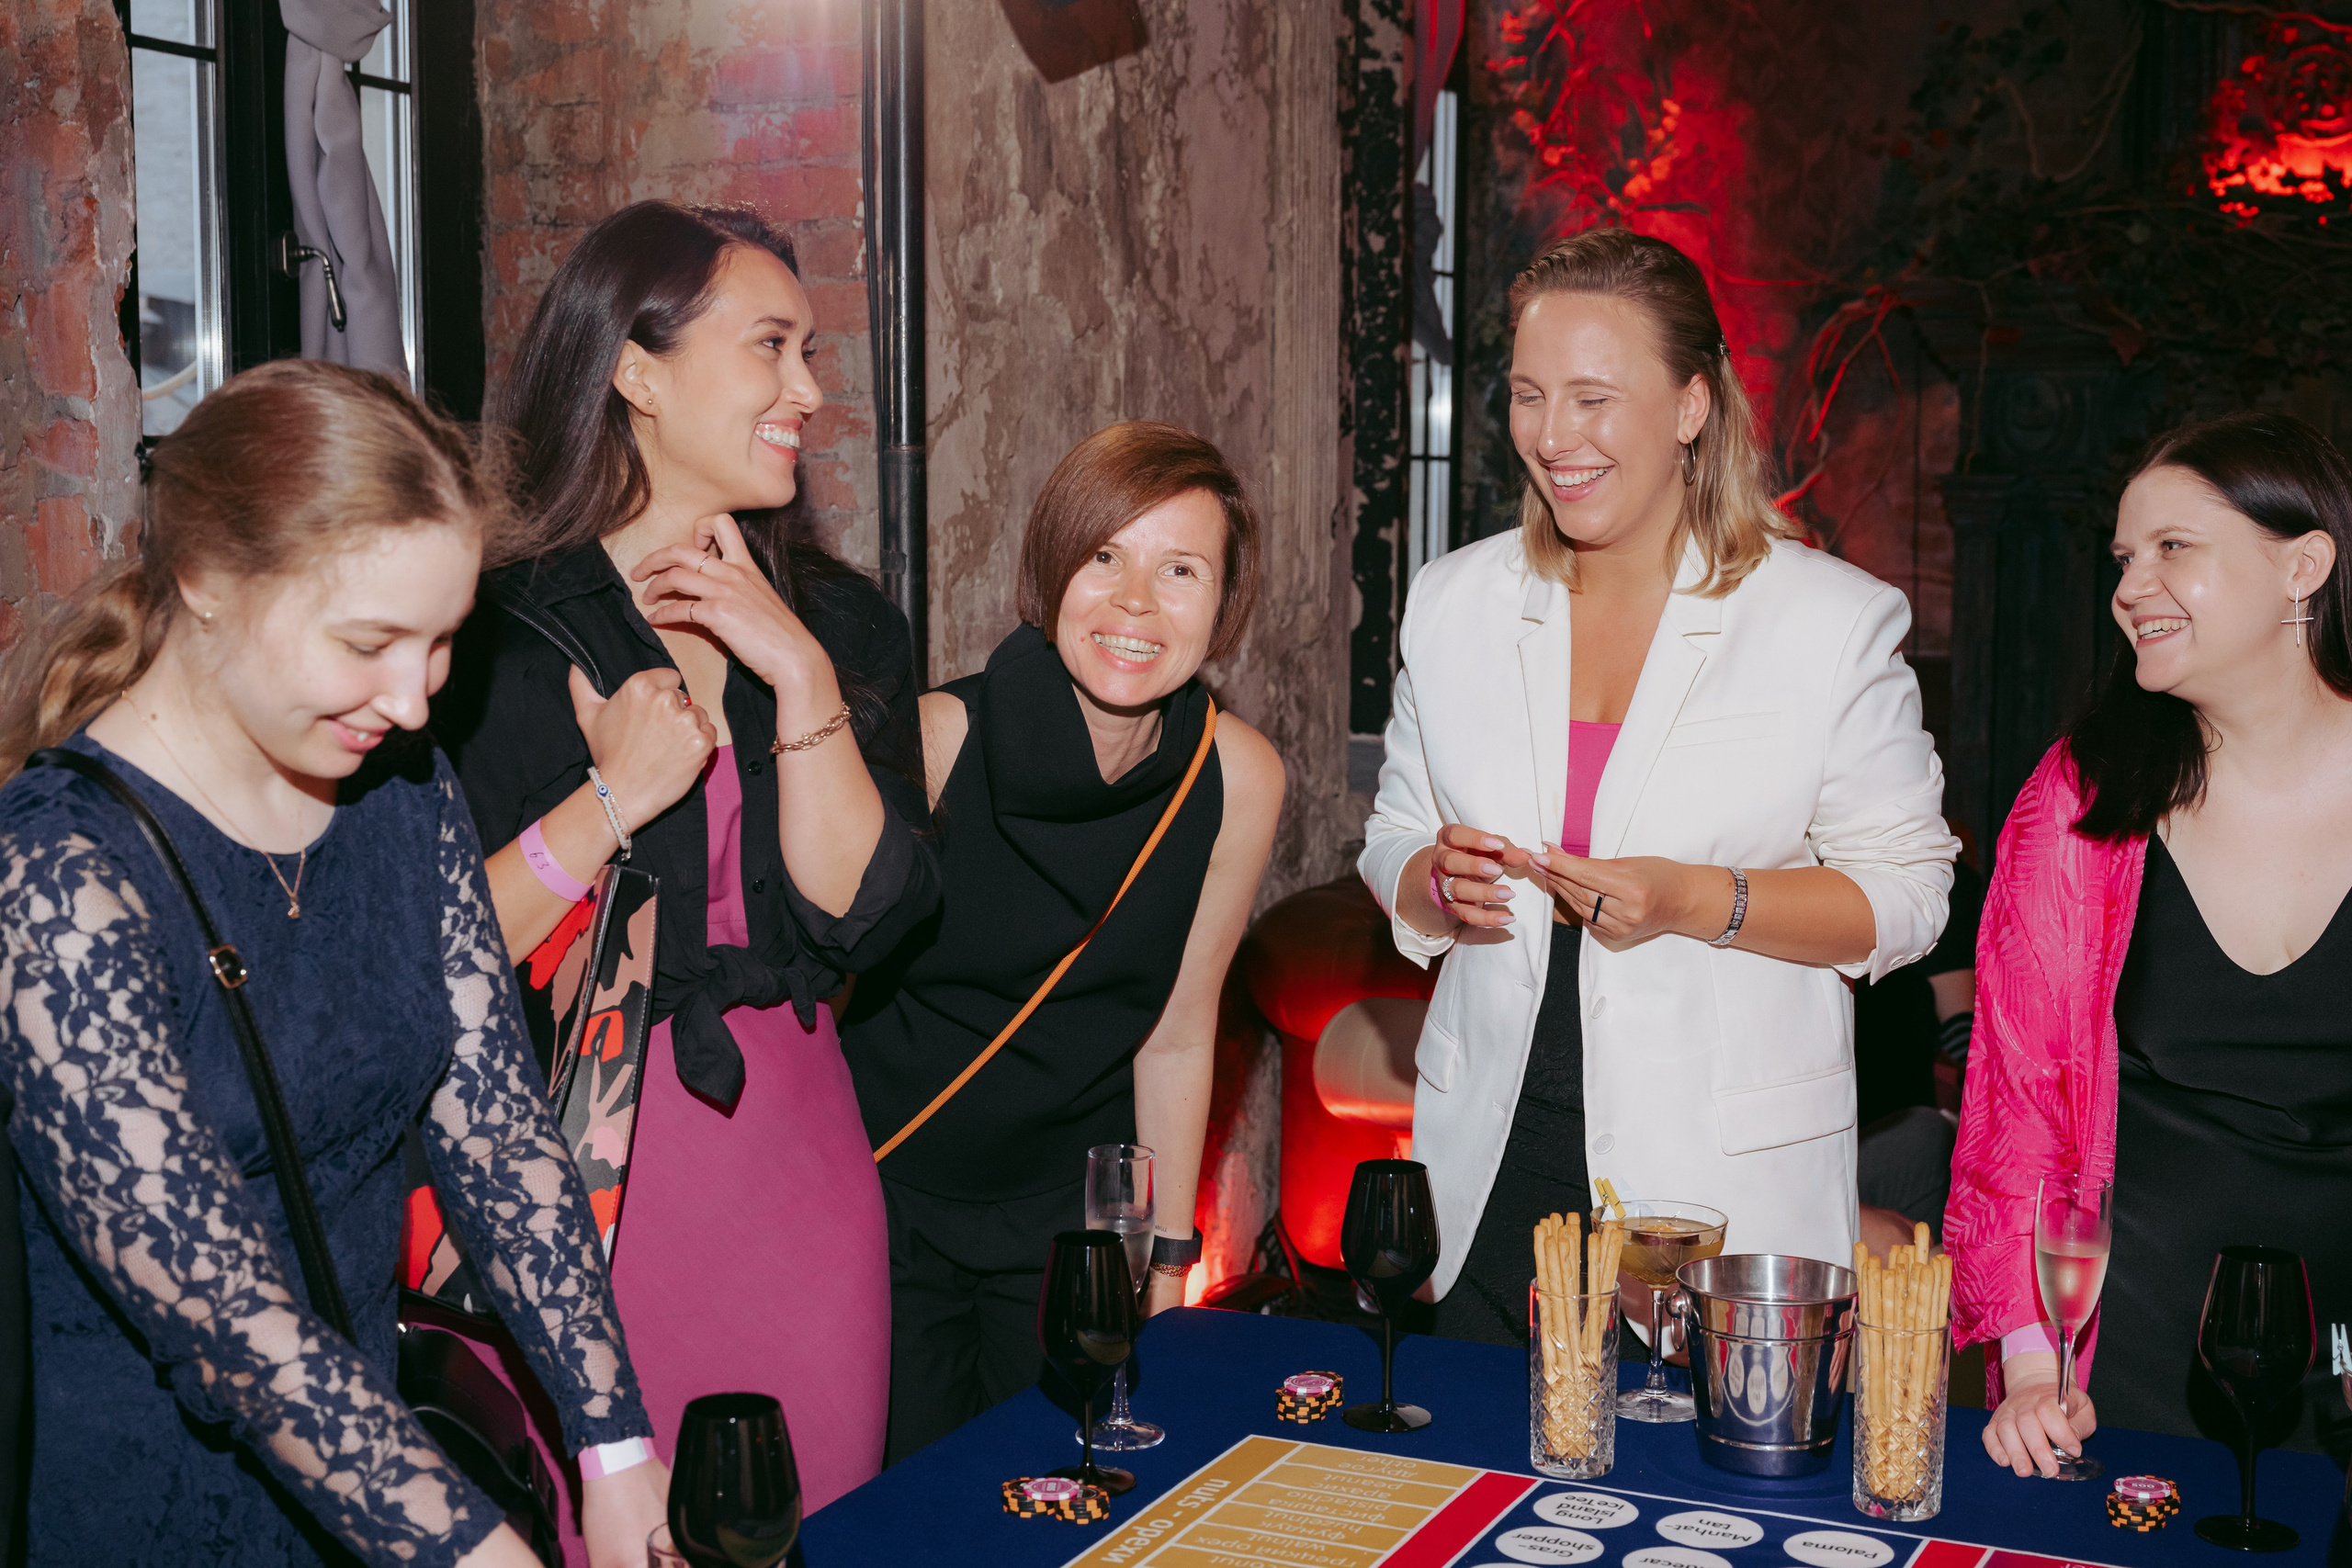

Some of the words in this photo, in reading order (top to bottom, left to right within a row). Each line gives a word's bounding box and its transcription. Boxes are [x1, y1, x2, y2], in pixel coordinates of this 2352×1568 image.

[1338, 1462, 1418, 1478] другое
[1357, 1456, 1417, 1468] other
[1323, 1473, 1404, 1490] peanut
[1177, 1478, 1231, 1508] nuts
[1311, 1483, 1391, 1498] арахис
[1287, 1491, 1391, 1511] pistachio
[1269, 1498, 1385, 1522] фисташка
[1555, 1510, 1603, 1525] Long
[1556, 1503, 1616, 1517] Island
[1256, 1521, 1346, 1540] фундук
[1699, 1518, 1731, 1530] tan
[1101, 1518, 1174, 1563] орехи
[1665, 1524, 1752, 1542] Manhat-
[1195, 1536, 1250, 1551] орех
[1248, 1534, 1326, 1551] walnut
[1511, 1533, 1596, 1551] shopper
[1802, 1540, 1878, 1559] Paloma
[1256, 1546, 1357, 1568] грецкий
[1519, 1544, 1574, 1558] Gras-
